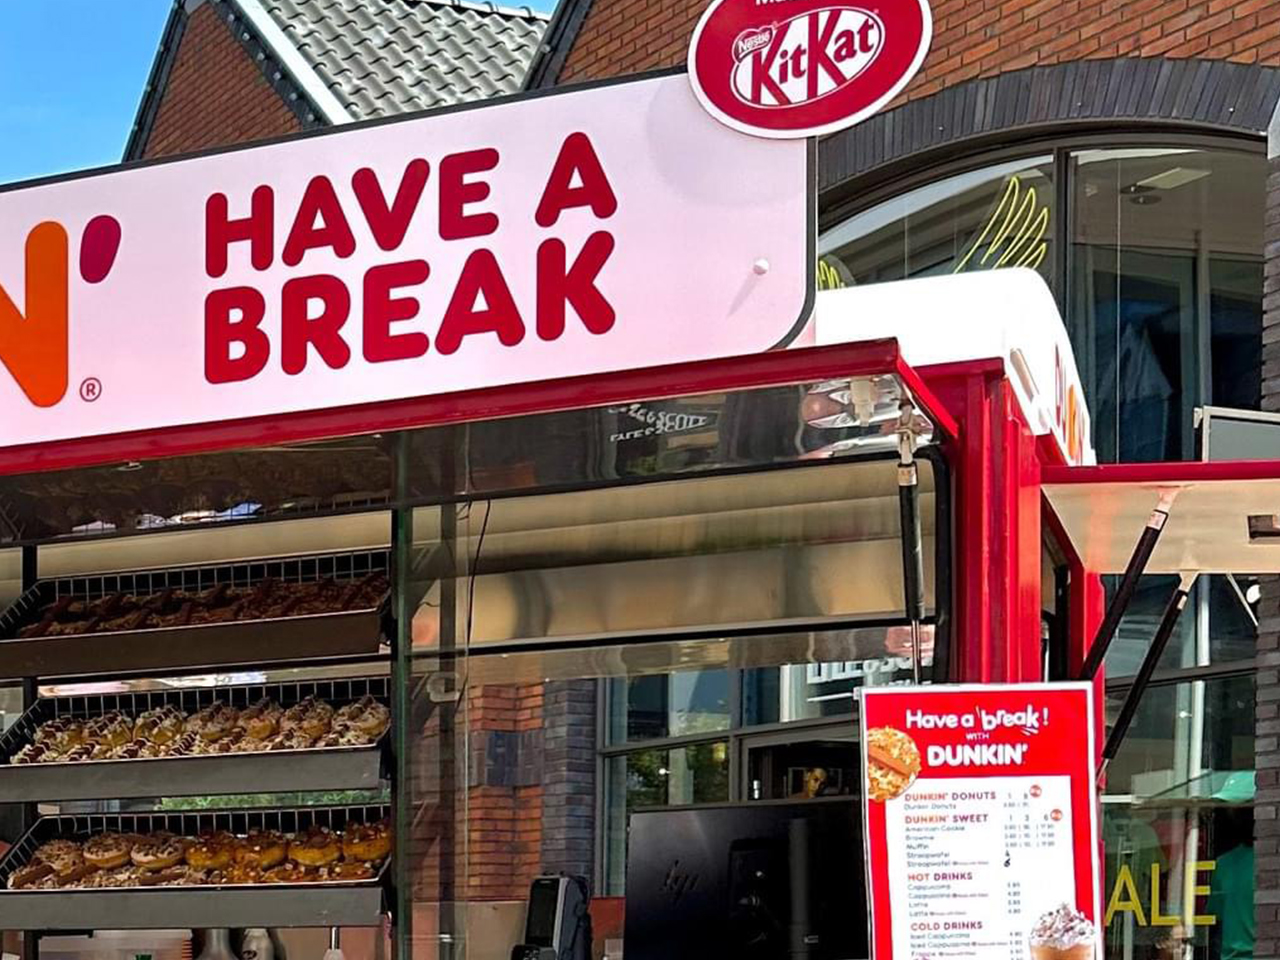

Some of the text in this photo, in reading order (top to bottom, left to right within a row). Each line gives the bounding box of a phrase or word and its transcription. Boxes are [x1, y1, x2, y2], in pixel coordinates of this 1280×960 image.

[751, 8, 875, 105] KitKat
[205, 132, 617, 278] HAVE A
[204, 230, 616, 385] BREAK
[906, 709, 958, 729] Have
[961, 714, 975, 728] a
[966, 732, 990, 740] WITH
[927, 743, 1028, 767] DUNKIN'
[951, 791, 997, 801] DONUTS
[952, 814, 989, 823] SWEET
[908, 872, 973, 882] HOT DRINKS
[1104, 860, 1217, 927] ALE
[910, 921, 983, 931] COLD DRINKS
